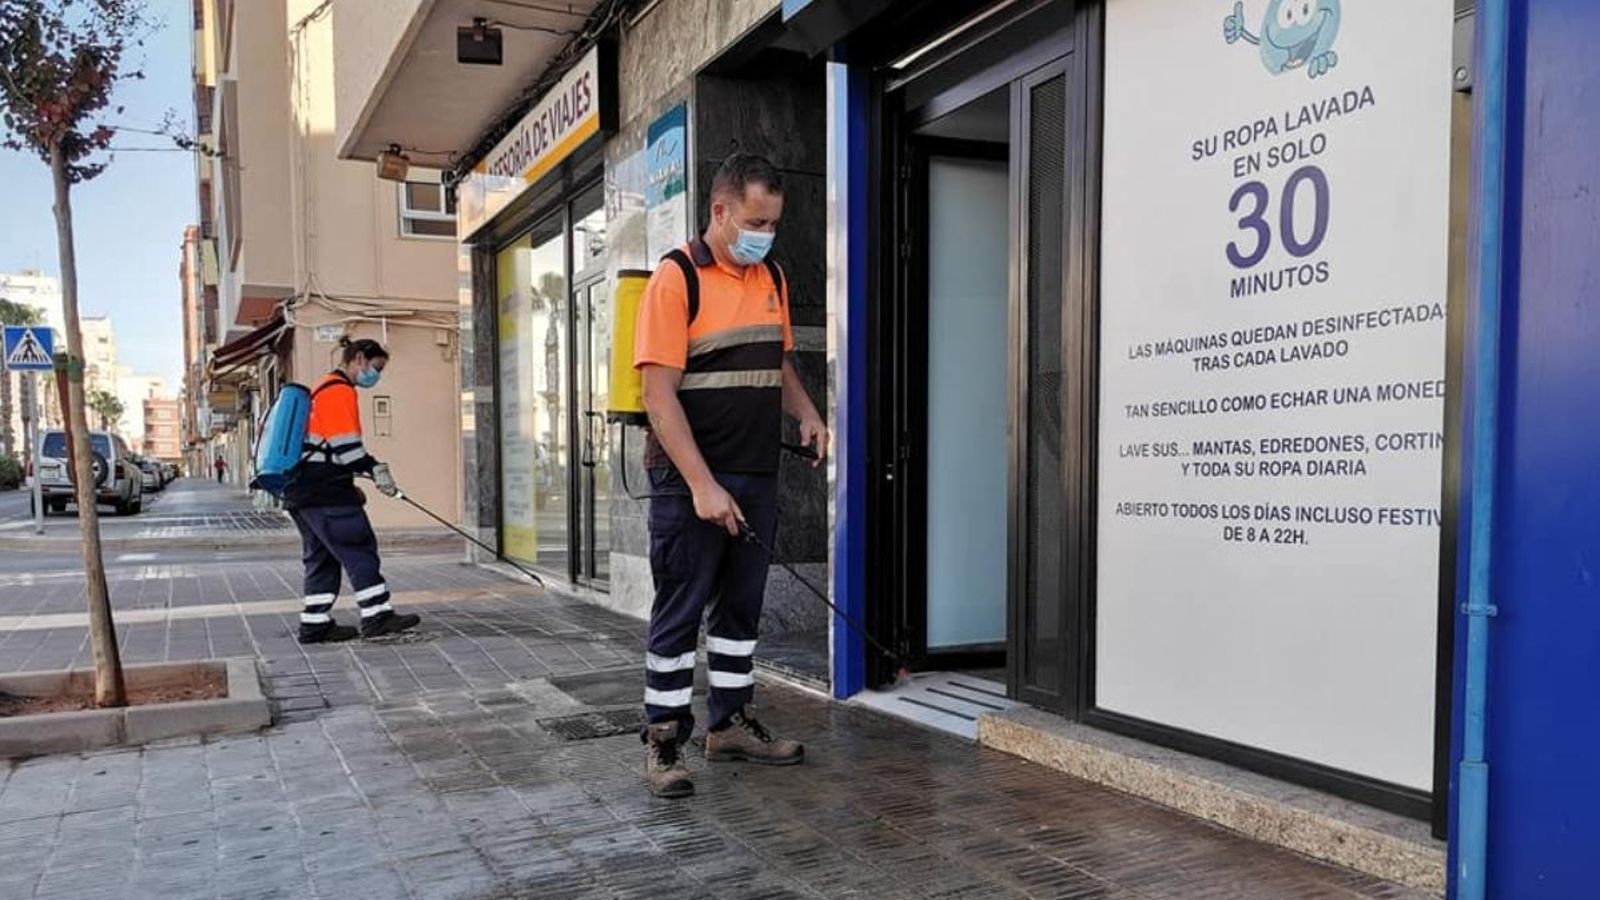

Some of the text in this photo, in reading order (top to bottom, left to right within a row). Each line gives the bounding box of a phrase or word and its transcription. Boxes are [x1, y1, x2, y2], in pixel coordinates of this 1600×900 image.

[533, 111, 548, 157] DE
[549, 70, 591, 142] VIAJES
[1192, 85, 1375, 161] SU ROPA LAVADA
[1233, 133, 1327, 178] EN SOLO
[1226, 165, 1330, 269] 30
[1230, 261, 1329, 298] MINUTOS
[1129, 343, 1153, 359] LAS
[1231, 323, 1297, 347] QUEDAN
[1302, 302, 1448, 338] DESINFECTADA
[1193, 340, 1348, 373] TRAS CADA LAVADO
[1126, 404, 1149, 419] TAN
[1151, 399, 1218, 417] SENCILLO
[1221, 395, 1267, 412] COMO
[1270, 389, 1328, 408] ECHAR
[1333, 386, 1372, 405] UNA
[1119, 443, 1149, 458] LAVE
[1193, 440, 1255, 456] MANTAS,
[1260, 435, 1369, 455] EDREDONES,
[1181, 459, 1366, 477] Y TODA SU ROPA DIARIA
[1116, 502, 1168, 517] ABIERTO
[1173, 503, 1218, 519] TODOS
[1222, 505, 1250, 520] LOS
[1255, 501, 1291, 521] DÍAS
[1295, 506, 1373, 524] INCLUSO
[1224, 526, 1309, 545] DE 8 A 22H.
